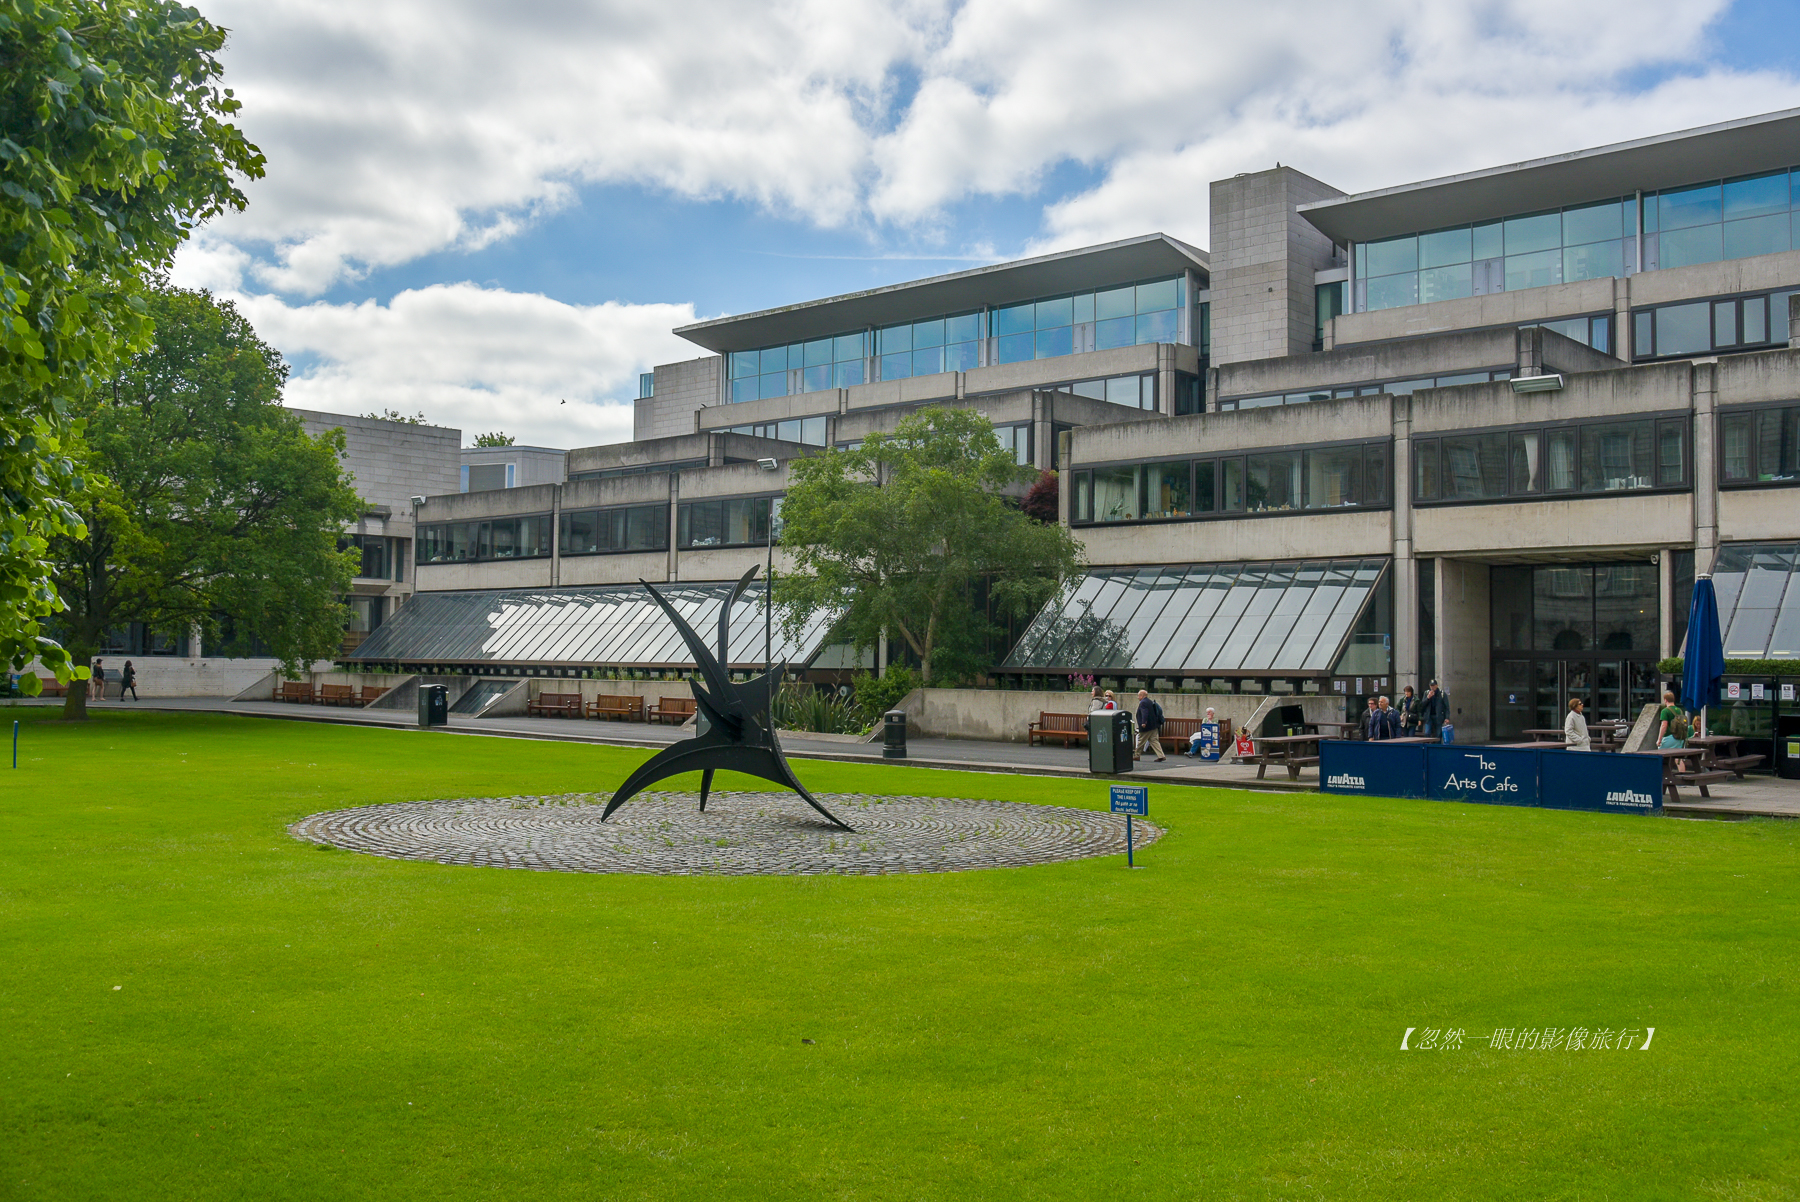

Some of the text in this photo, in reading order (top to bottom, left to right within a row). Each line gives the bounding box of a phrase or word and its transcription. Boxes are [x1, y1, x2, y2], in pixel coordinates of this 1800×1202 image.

[1464, 754, 1496, 770] The
[1327, 773, 1365, 785] LAVAZZA
[1444, 773, 1518, 793] Arts Cafe
[1606, 790, 1653, 804] LAVAZZA
